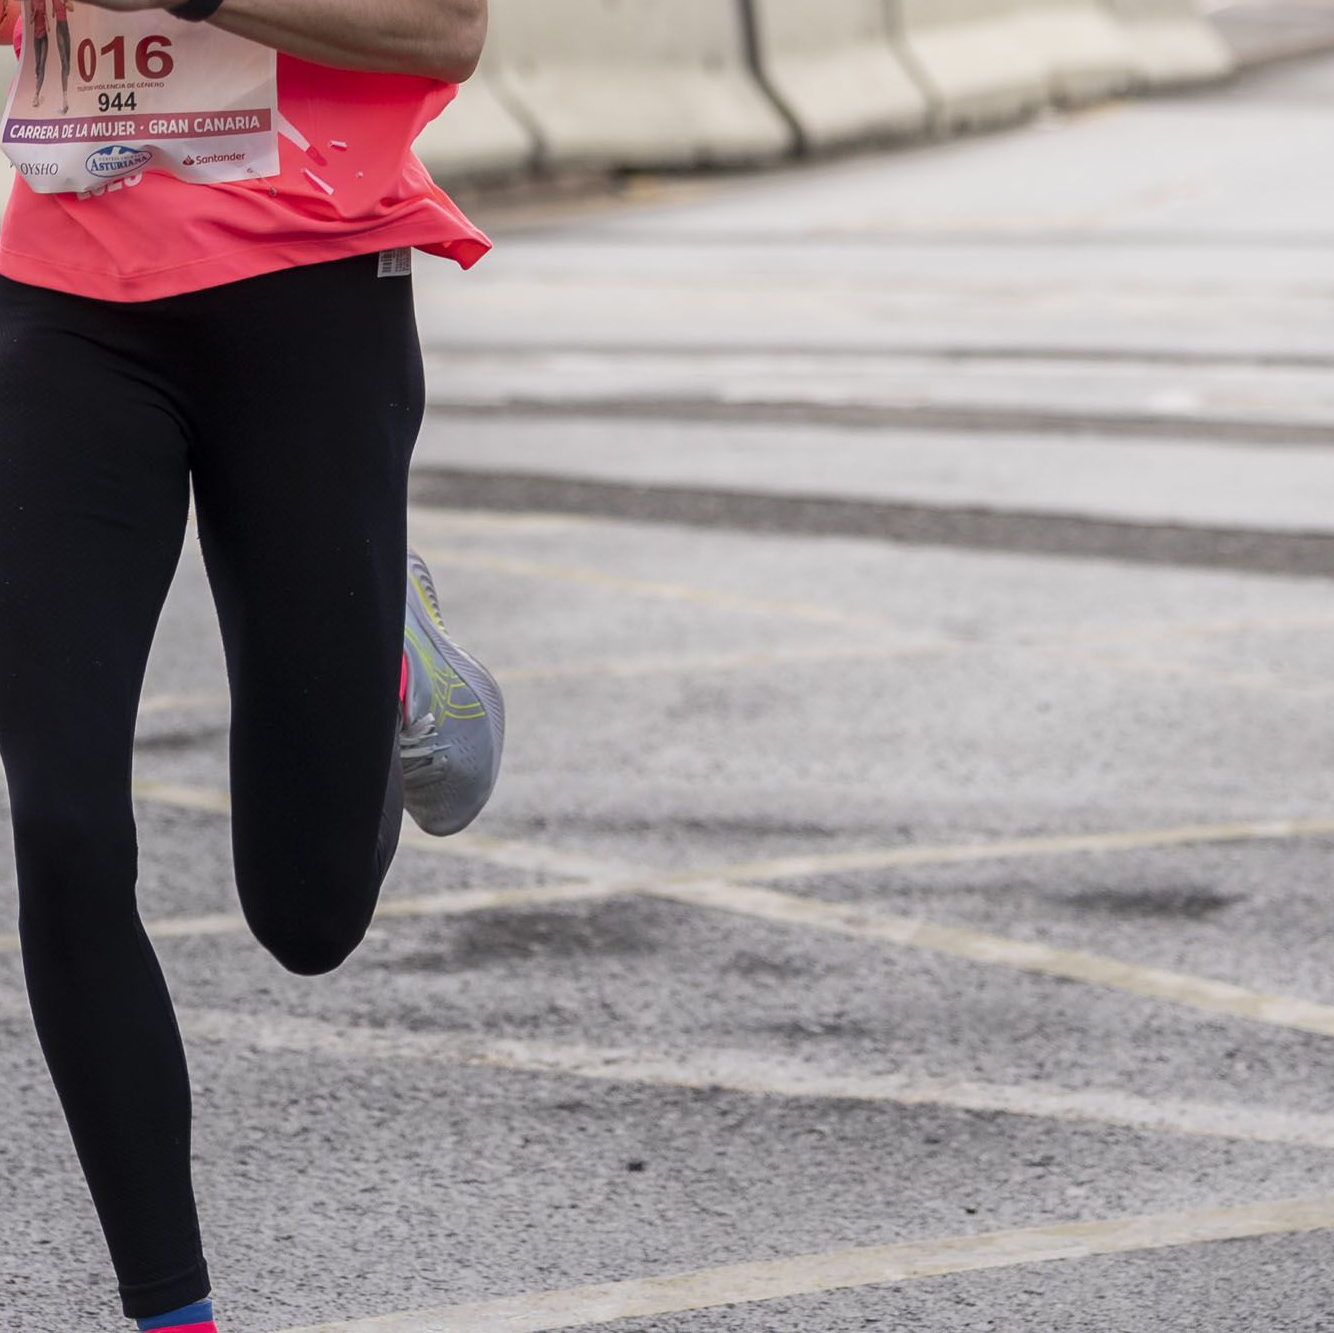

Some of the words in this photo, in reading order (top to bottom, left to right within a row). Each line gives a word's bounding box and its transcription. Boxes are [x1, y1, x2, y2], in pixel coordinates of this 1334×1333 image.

[77, 35, 174, 83] 016
[98, 91, 137, 112] 944
[10, 124, 59, 139] CARRERA
[61, 124, 74, 138] DE
[75, 123, 88, 138] LA
[90, 121, 135, 137] MUJER
[149, 119, 189, 135] GRAN
[193, 115, 260, 133] CANARIA
[20, 163, 59, 175] OYSHO
[196, 152, 245, 165] Santander
